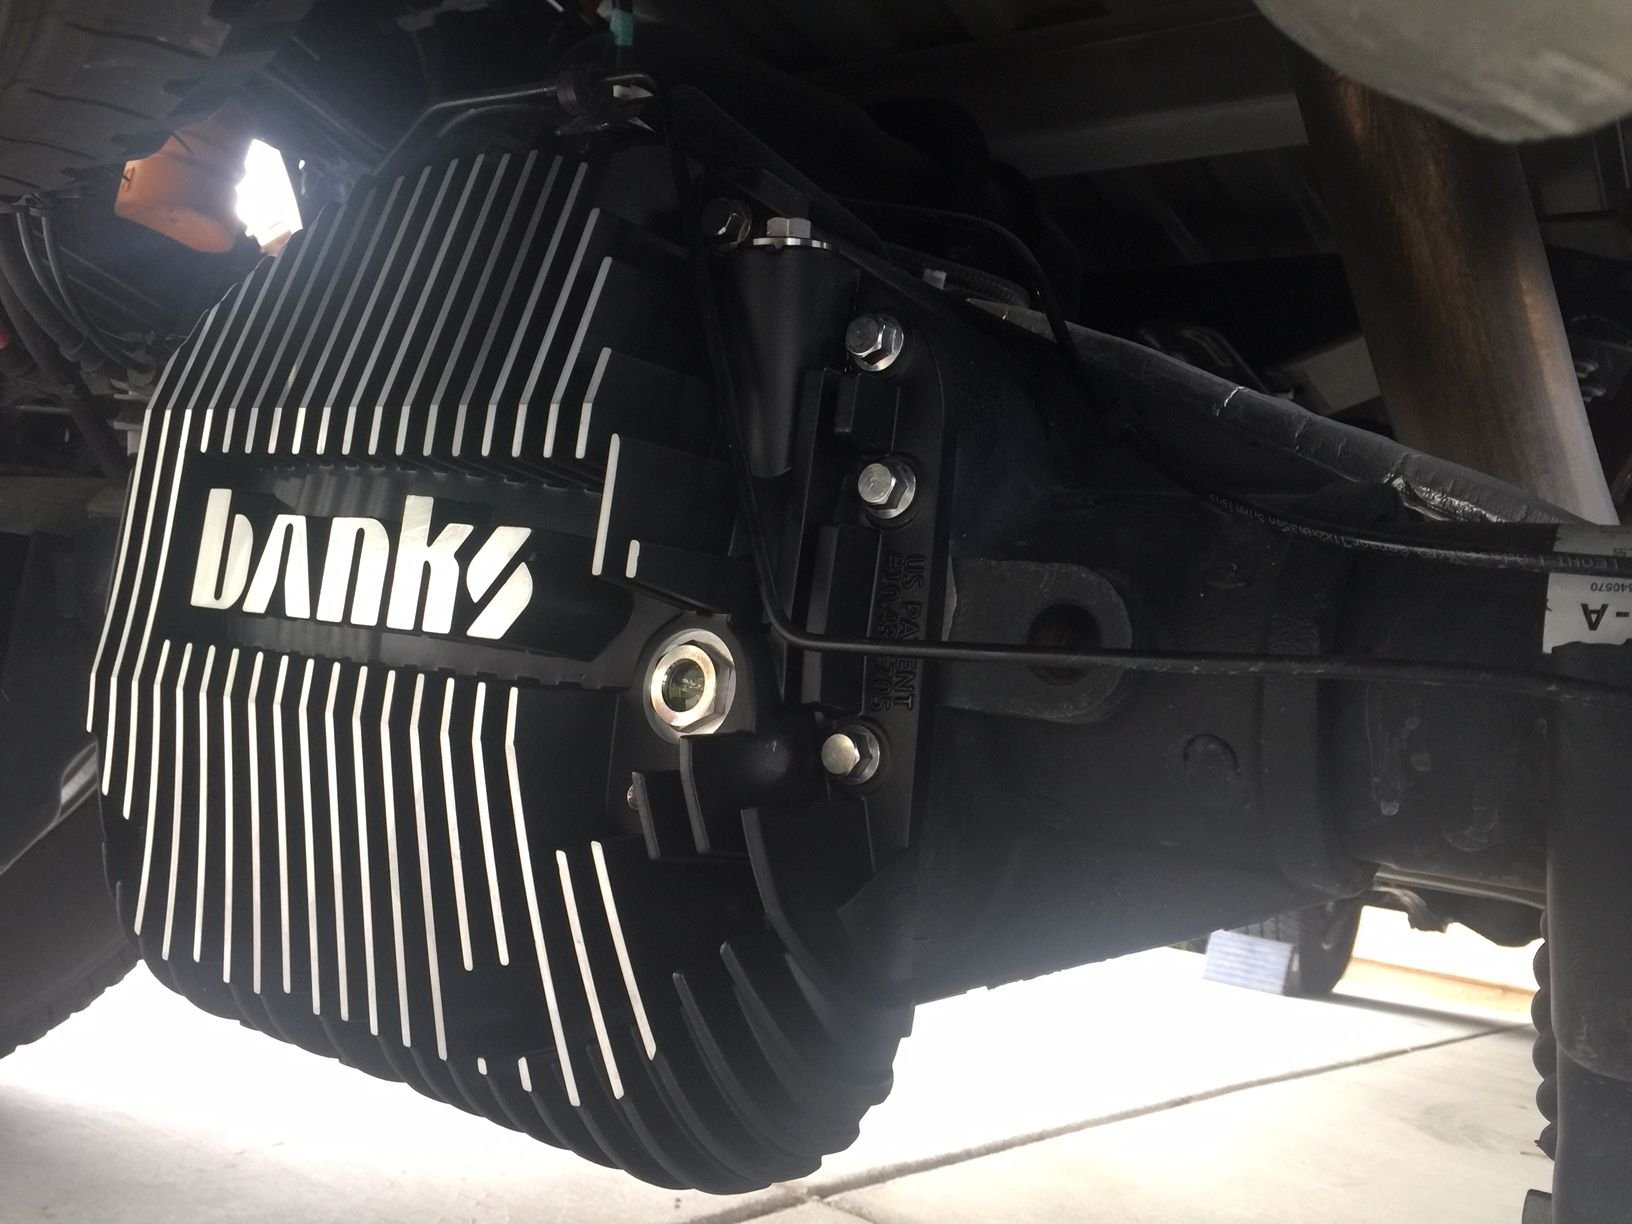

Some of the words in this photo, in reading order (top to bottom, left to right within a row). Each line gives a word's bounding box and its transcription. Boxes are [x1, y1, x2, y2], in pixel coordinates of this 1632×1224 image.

[190, 487, 534, 640] banks
[902, 553, 926, 589] US
[893, 600, 922, 712] PAENT
